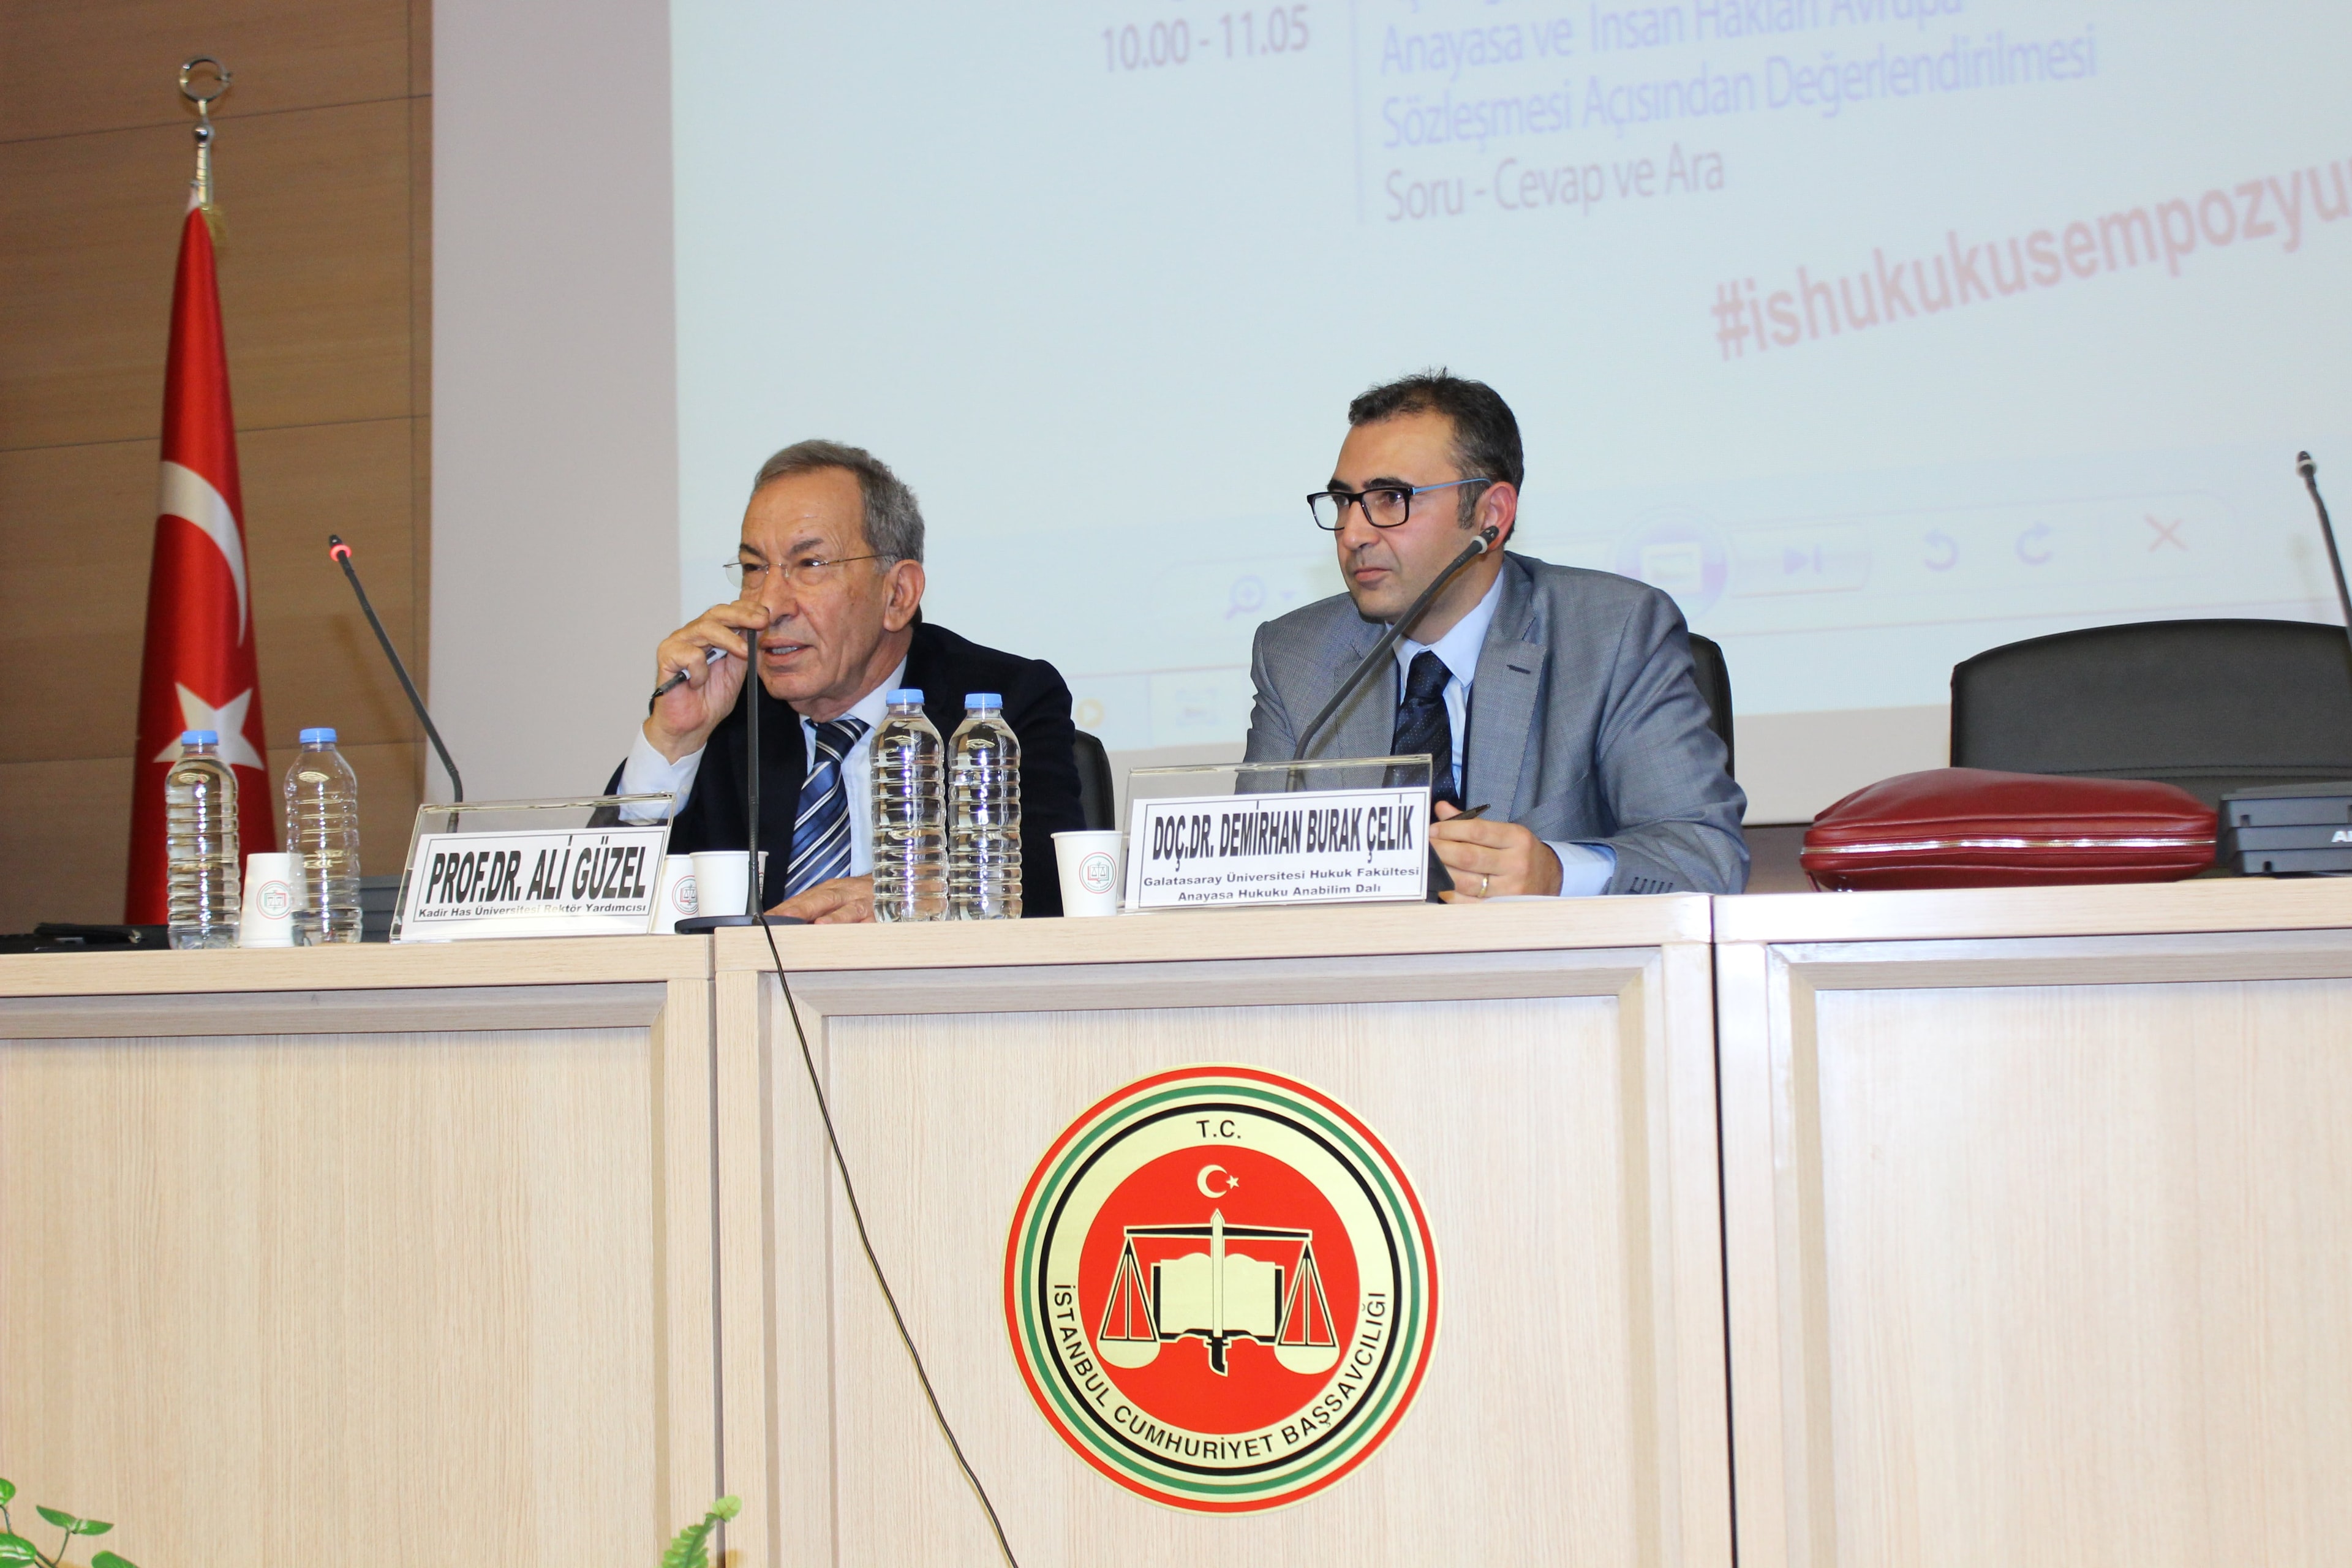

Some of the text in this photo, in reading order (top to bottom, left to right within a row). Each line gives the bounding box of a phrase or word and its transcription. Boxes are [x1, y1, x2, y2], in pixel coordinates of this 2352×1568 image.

[1102, 18, 1189, 73] 10.00
[1219, 4, 1310, 58] 11.05
[1379, 23, 1525, 83] Anayasa
[1529, 17, 1574, 58] ve
[1381, 21, 2099, 154] Sözleşmesi Açısından Değerlendirilmesi
[1384, 168, 1466, 223] Soru
[1493, 156, 1605, 218] Cevap
[1612, 157, 1656, 199] ve
[1664, 141, 1725, 196] Ara
[1710, 156, 2352, 363] #ishukukusempozyu
[1152, 794, 1415, 872] DOÇ.DR. DEMİRHAN BURAK ÇELİK
[426, 835, 647, 905] PROF.DR. ALİ GÜZEL
[1144, 865, 1420, 887] Galatasaray Üniversitesi Hukuk Fakültesi
[1178, 883, 1381, 902] Anayasa Hukuku Anabilim Dalı
[418, 902, 646, 918] Kadir Has Üniversitesi Rektör Yardımcısı
[1196, 1120, 1242, 1139] T.C.
[1053, 1283, 1387, 1460] İSTANBUL CUMHURİYET BAŞSAVCILIĞI
